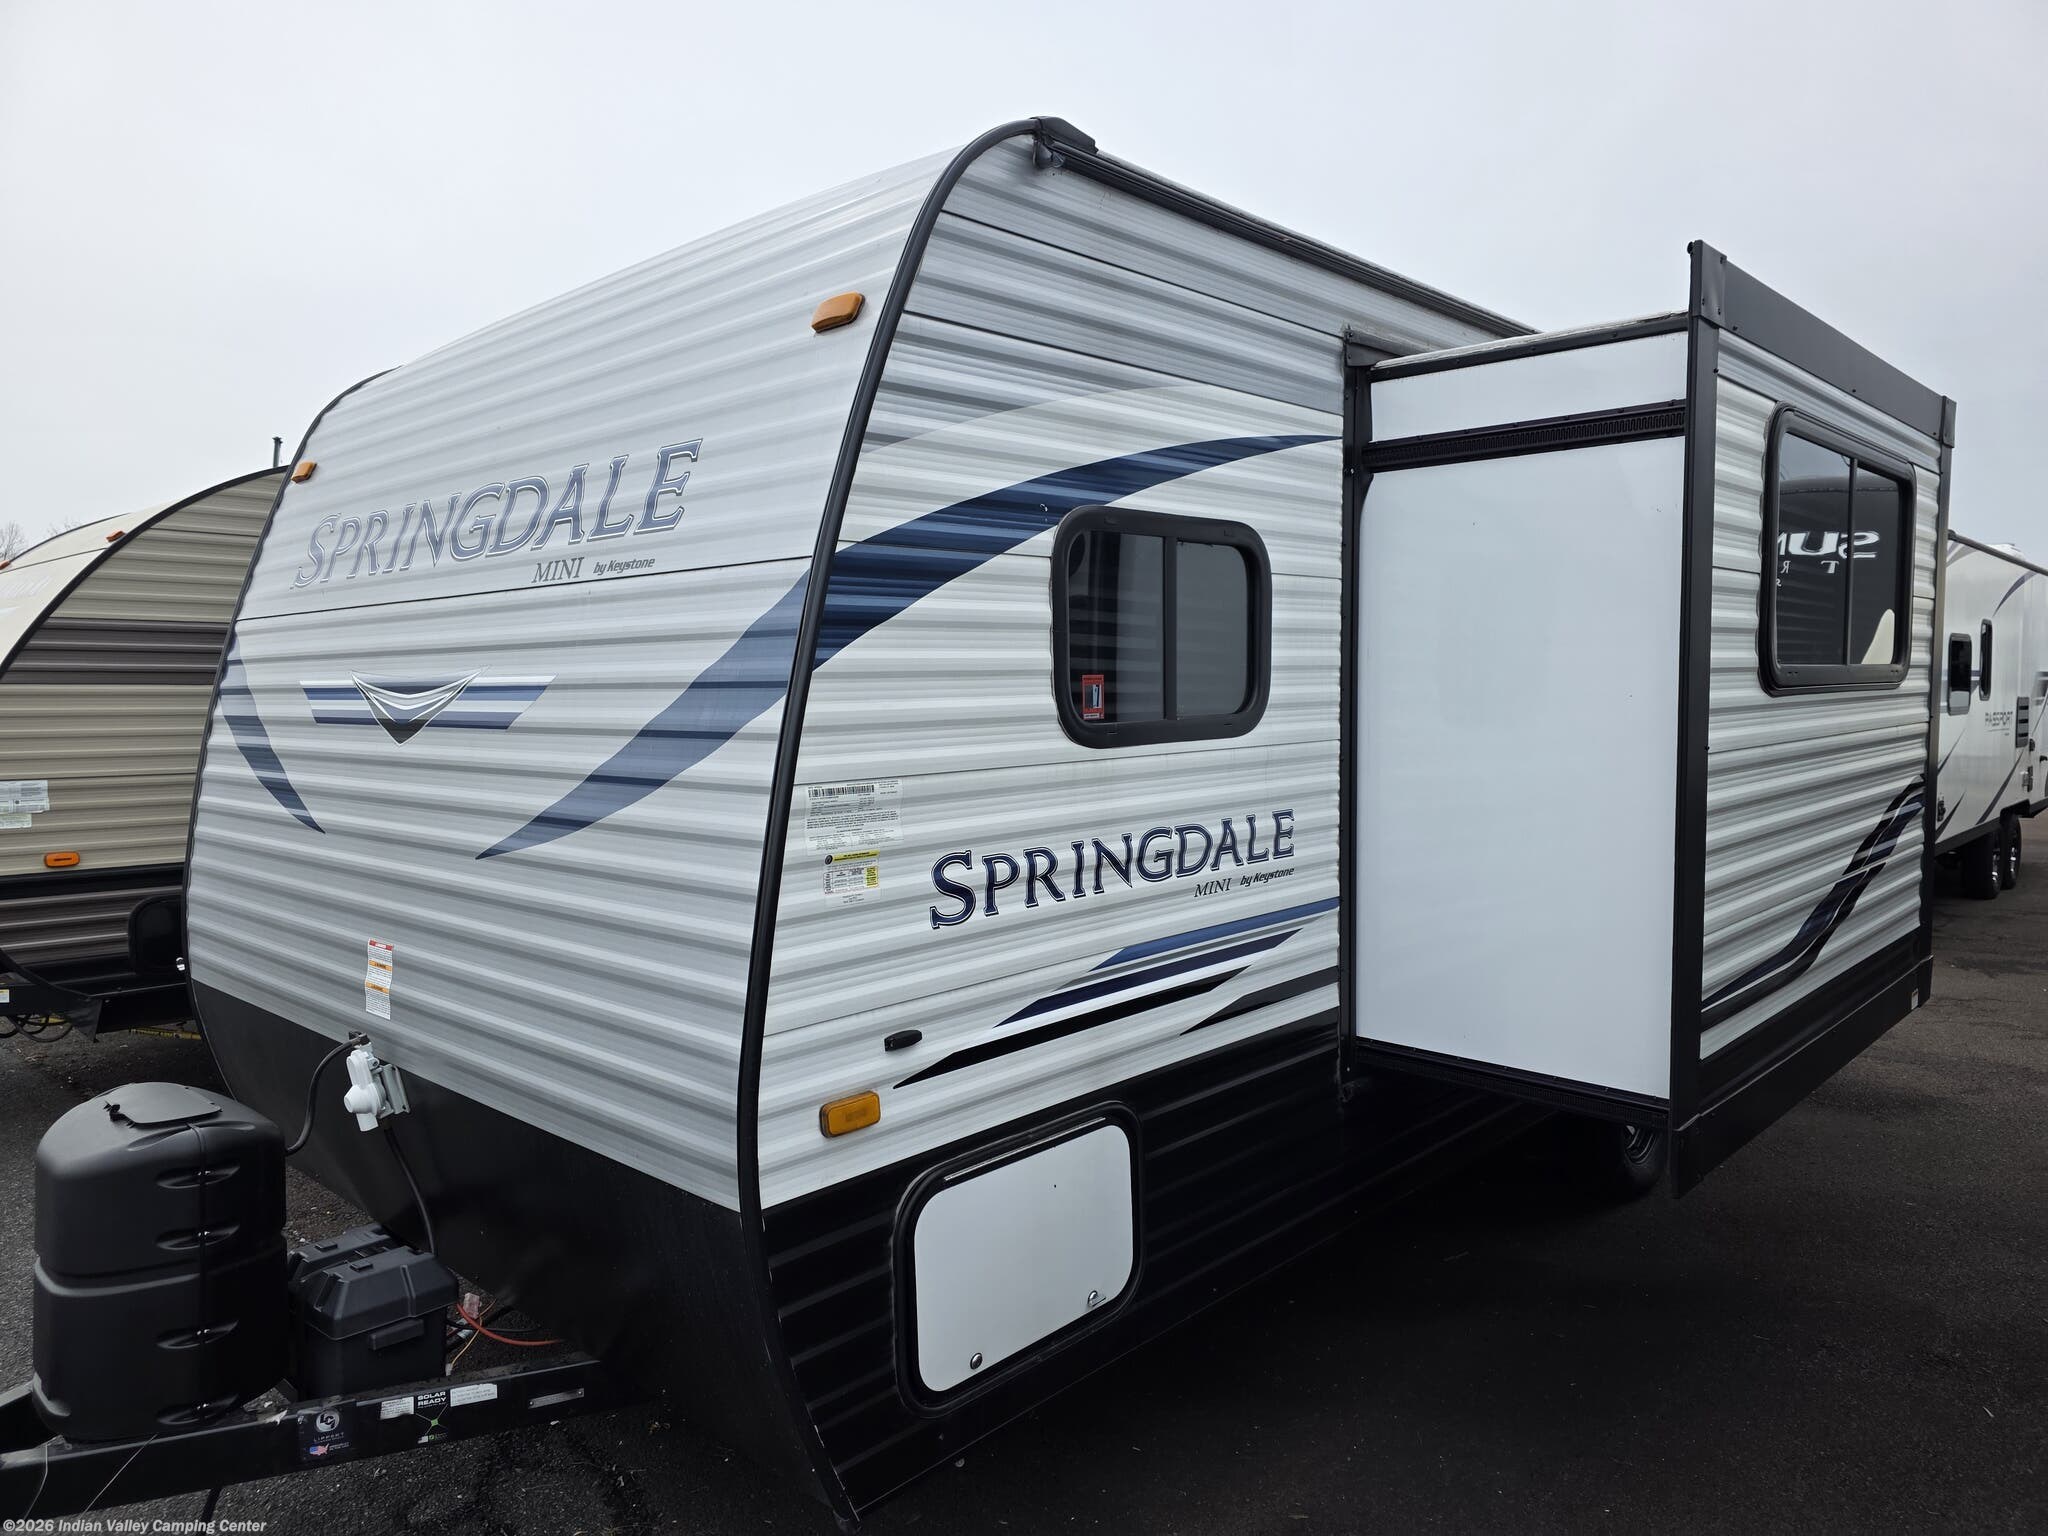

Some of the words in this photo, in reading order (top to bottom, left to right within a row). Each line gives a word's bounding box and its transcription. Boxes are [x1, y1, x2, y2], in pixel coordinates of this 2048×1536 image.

[289, 438, 703, 590] SPRINGDALE
[531, 557, 585, 584] MINI
[593, 561, 606, 576] by
[607, 557, 656, 574] Keystone
[929, 808, 1295, 929] SPRINGDALE
[1194, 878, 1232, 898] MINI
[1240, 875, 1253, 887] by
[1253, 867, 1295, 884] Keystone
[417, 1391, 447, 1401] SOLAR
[417, 1397, 447, 1407] READY
